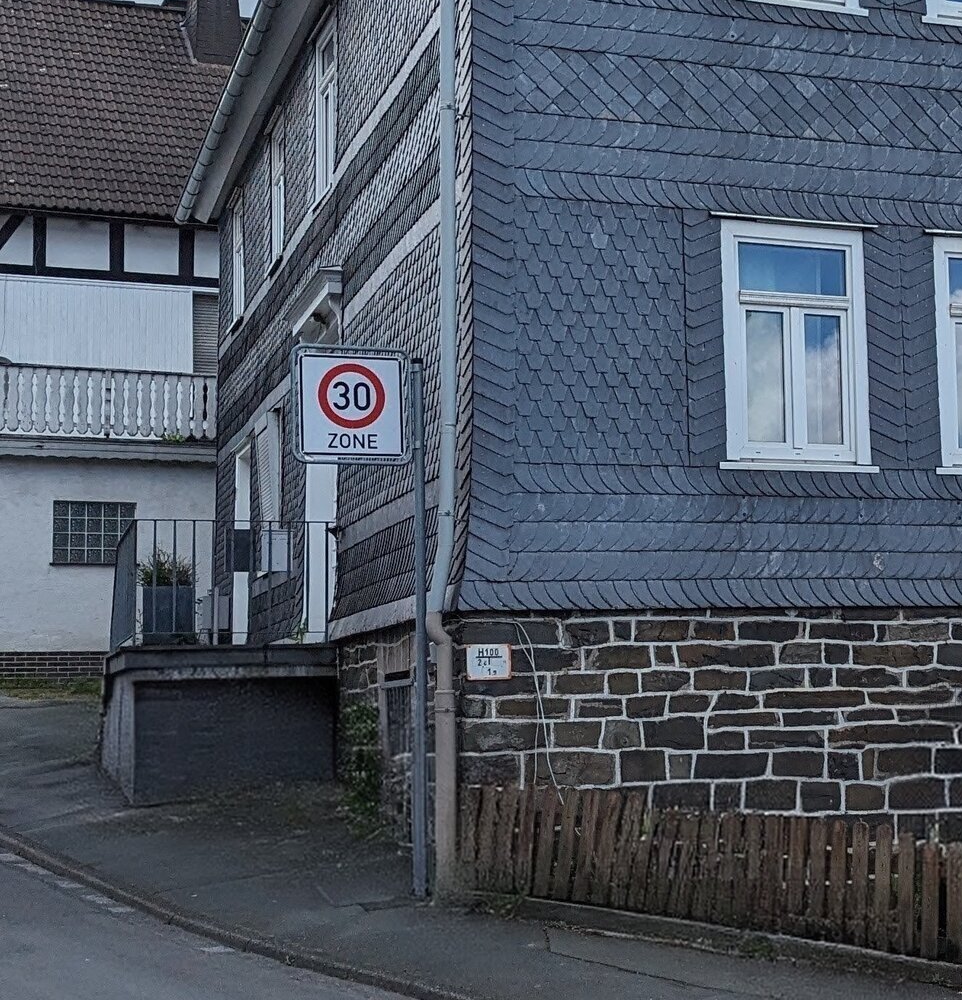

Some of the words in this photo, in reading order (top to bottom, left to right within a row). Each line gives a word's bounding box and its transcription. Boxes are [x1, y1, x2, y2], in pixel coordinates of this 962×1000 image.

[333, 381, 371, 411] 30
[328, 433, 378, 449] ZONE
[478, 648, 499, 656] H100
